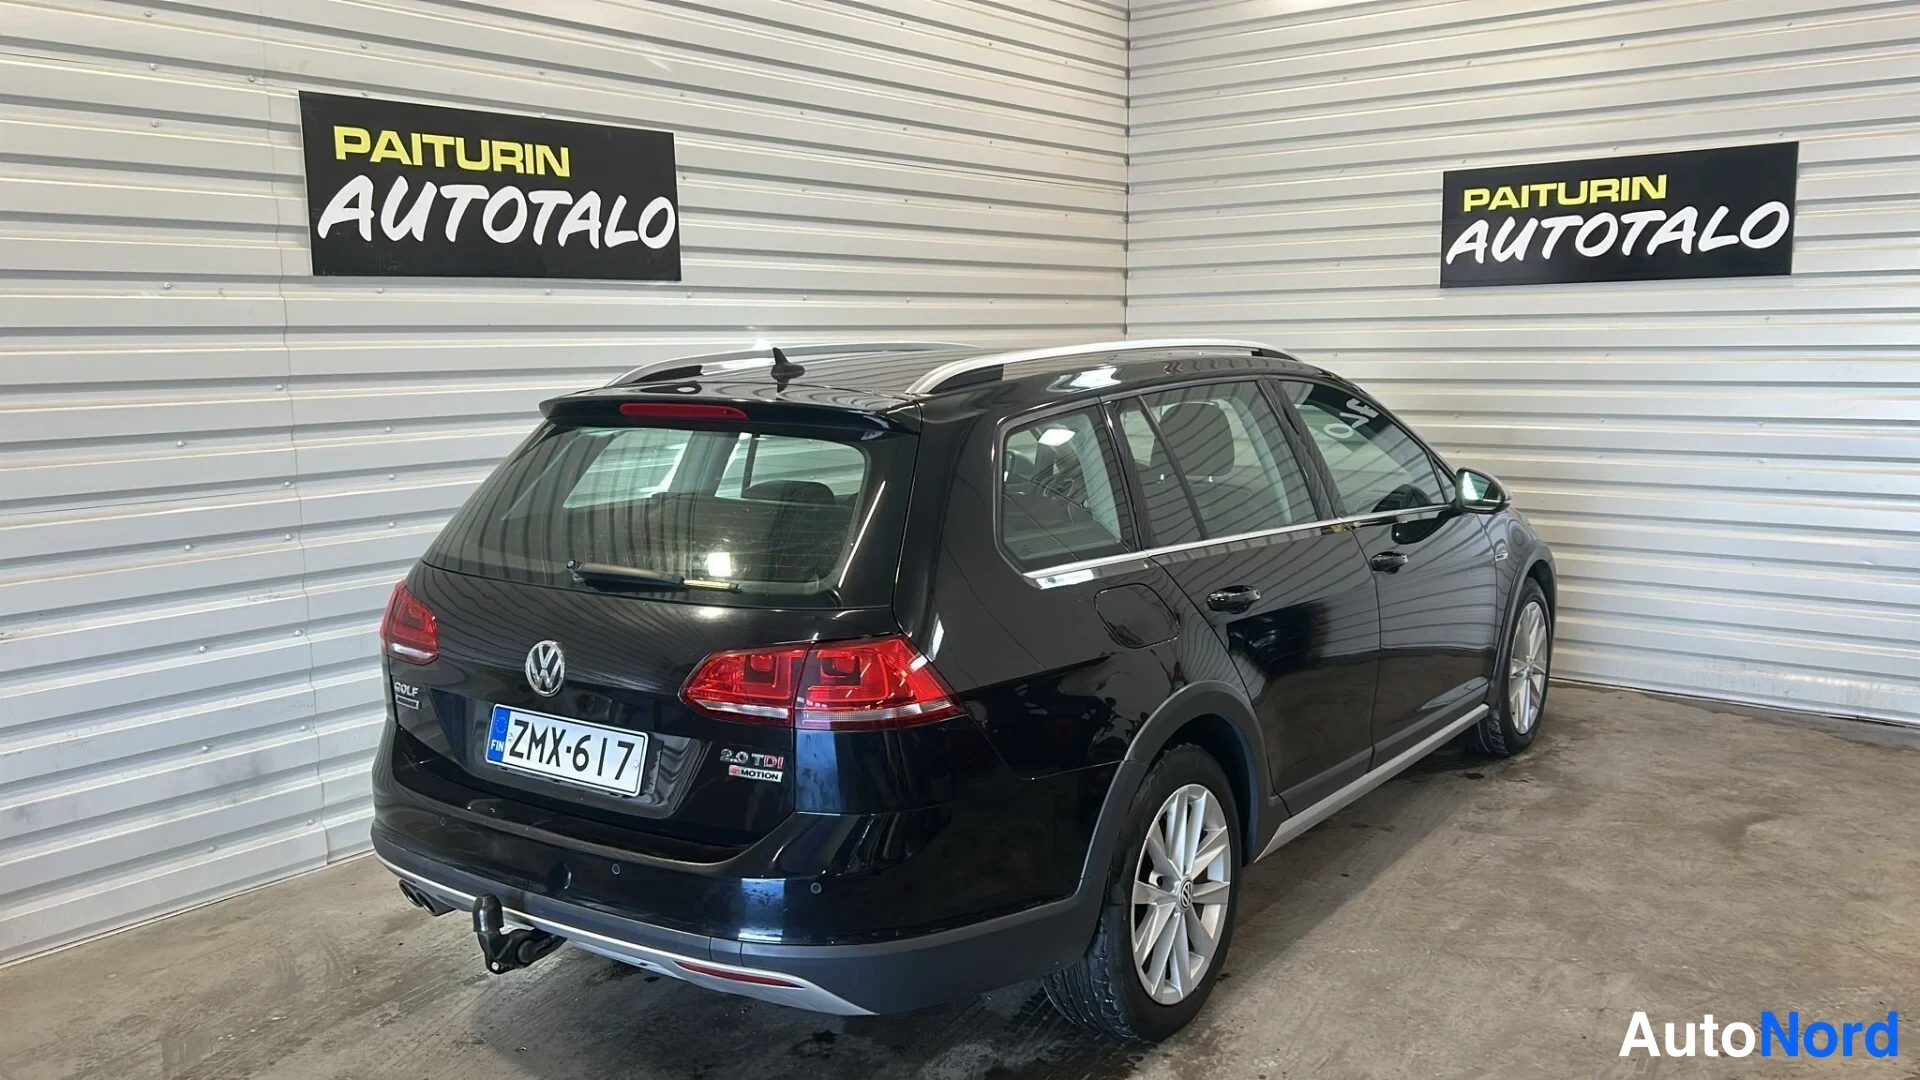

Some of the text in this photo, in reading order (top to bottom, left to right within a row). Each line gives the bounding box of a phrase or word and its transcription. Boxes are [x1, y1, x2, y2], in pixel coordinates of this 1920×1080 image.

[333, 125, 571, 178] PAITURIN
[317, 174, 676, 249] AUTOTALO
[1463, 174, 1668, 212] PAITURIN
[1445, 200, 1790, 265] AUTOTALO
[394, 681, 419, 697] GOLF
[490, 739, 505, 753] FIN
[509, 719, 636, 781] ZMX-617
[720, 748, 784, 769] 2.0 TDI
